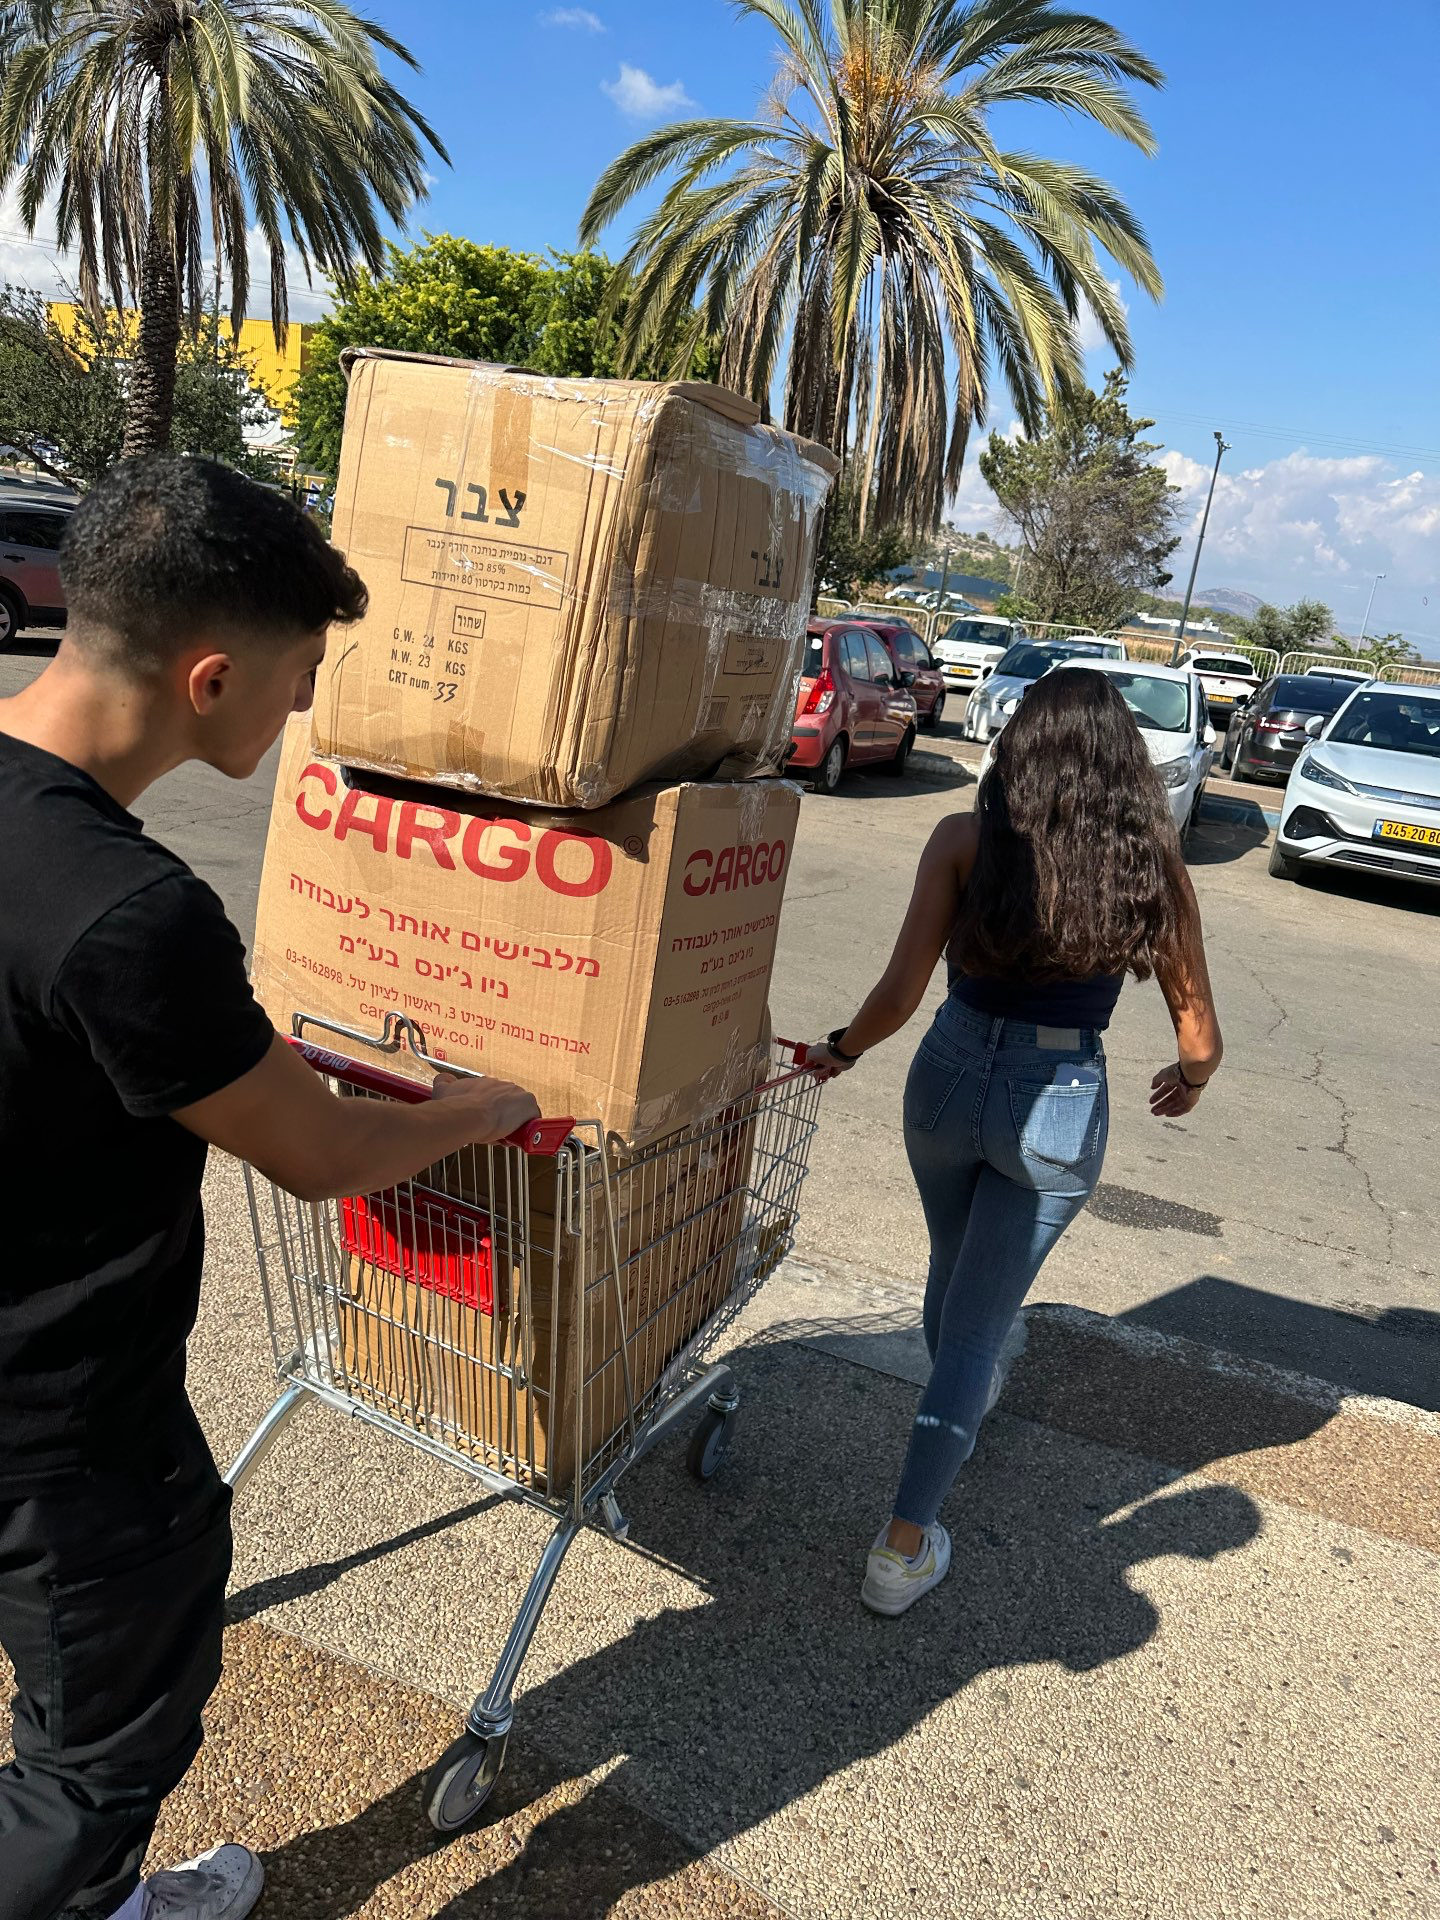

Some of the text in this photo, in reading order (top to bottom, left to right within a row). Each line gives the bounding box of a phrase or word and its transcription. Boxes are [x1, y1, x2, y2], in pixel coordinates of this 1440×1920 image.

[435, 477, 527, 528] צבר
[426, 538, 446, 550] לגבר
[471, 545, 497, 558] כותנה
[499, 549, 527, 562] גופיית
[486, 563, 506, 575] 85%
[431, 570, 531, 595] כמות בקרטון 80 יחידות
[457, 614, 482, 630] שחור
[423, 634, 435, 649] 24
[447, 639, 469, 655] KGS
[391, 648, 466, 676] N.W: 23 KGS
[388, 669, 458, 703] CRT num: 33
[295, 763, 613, 897] CARGO
[683, 839, 786, 897] CARGO
[290, 873, 600, 977] מלבישים אותך לעבודה
[671, 914, 775, 953] מלבישים אותך לעבודה
[285, 948, 343, 985] 03-5162898
[346, 974, 366, 991] טל.
[370, 983, 399, 1002] לציון
[481, 976, 509, 999] ניו
[403, 993, 441, 1016] ראשון
[460, 1010, 496, 1031] שביט
[501, 1022, 535, 1042] בומה
[539, 1032, 590, 1055] אברהם
